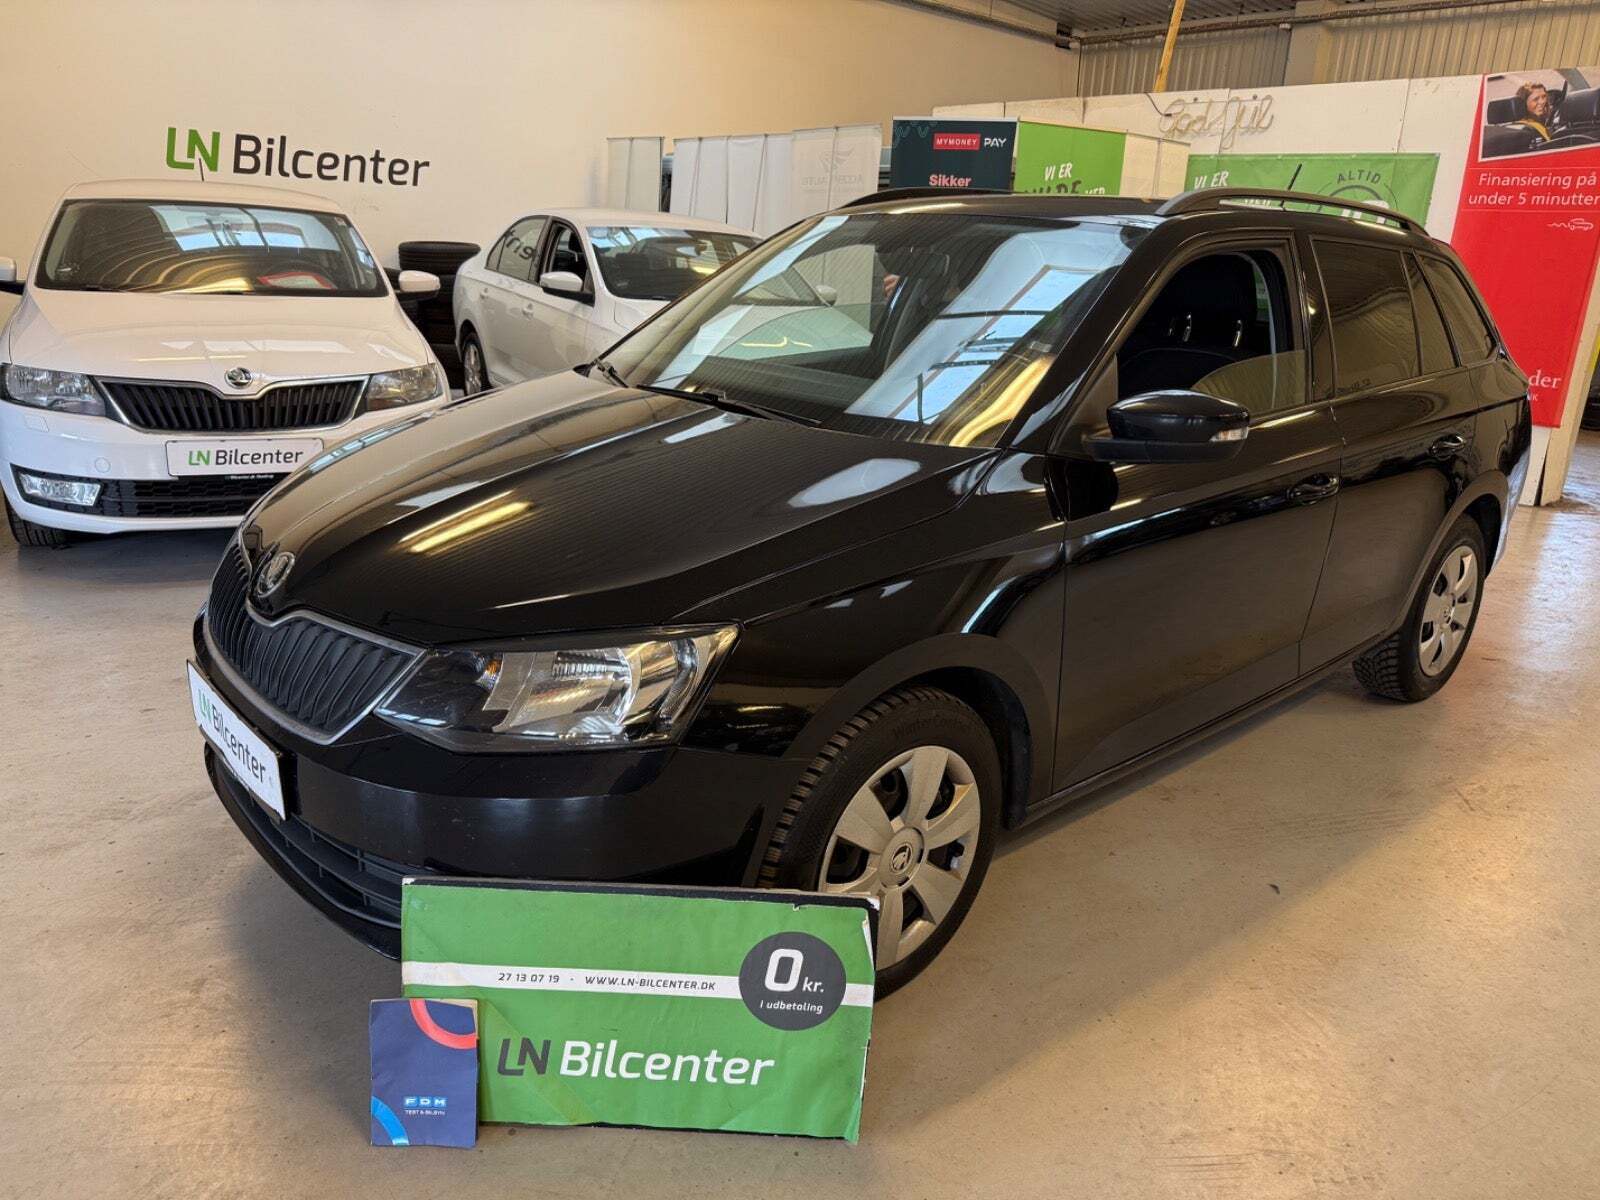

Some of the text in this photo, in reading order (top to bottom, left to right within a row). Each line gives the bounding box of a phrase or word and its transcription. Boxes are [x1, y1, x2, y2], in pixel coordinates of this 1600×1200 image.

[936, 137, 1007, 147] MYMONEY PAY
[166, 127, 430, 187] LN Bilcenter
[929, 174, 972, 187] Sikker
[1044, 162, 1073, 181] VI ER
[1194, 171, 1229, 190] VI ER
[1337, 169, 1382, 185] ALTID
[1478, 171, 1598, 190] Finansiering på
[1468, 191, 1600, 206] under 5 minutter
[188, 448, 304, 466] LN Bilcenter
[211, 703, 267, 783] Bilcenter
[764, 948, 825, 993] 0 kr.
[498, 972, 716, 991] 27 13 07 19 WWW.LN-BILCENTER.DK
[766, 1001, 824, 1015] udbetaling
[497, 1037, 775, 1085] LN Bilcenter
